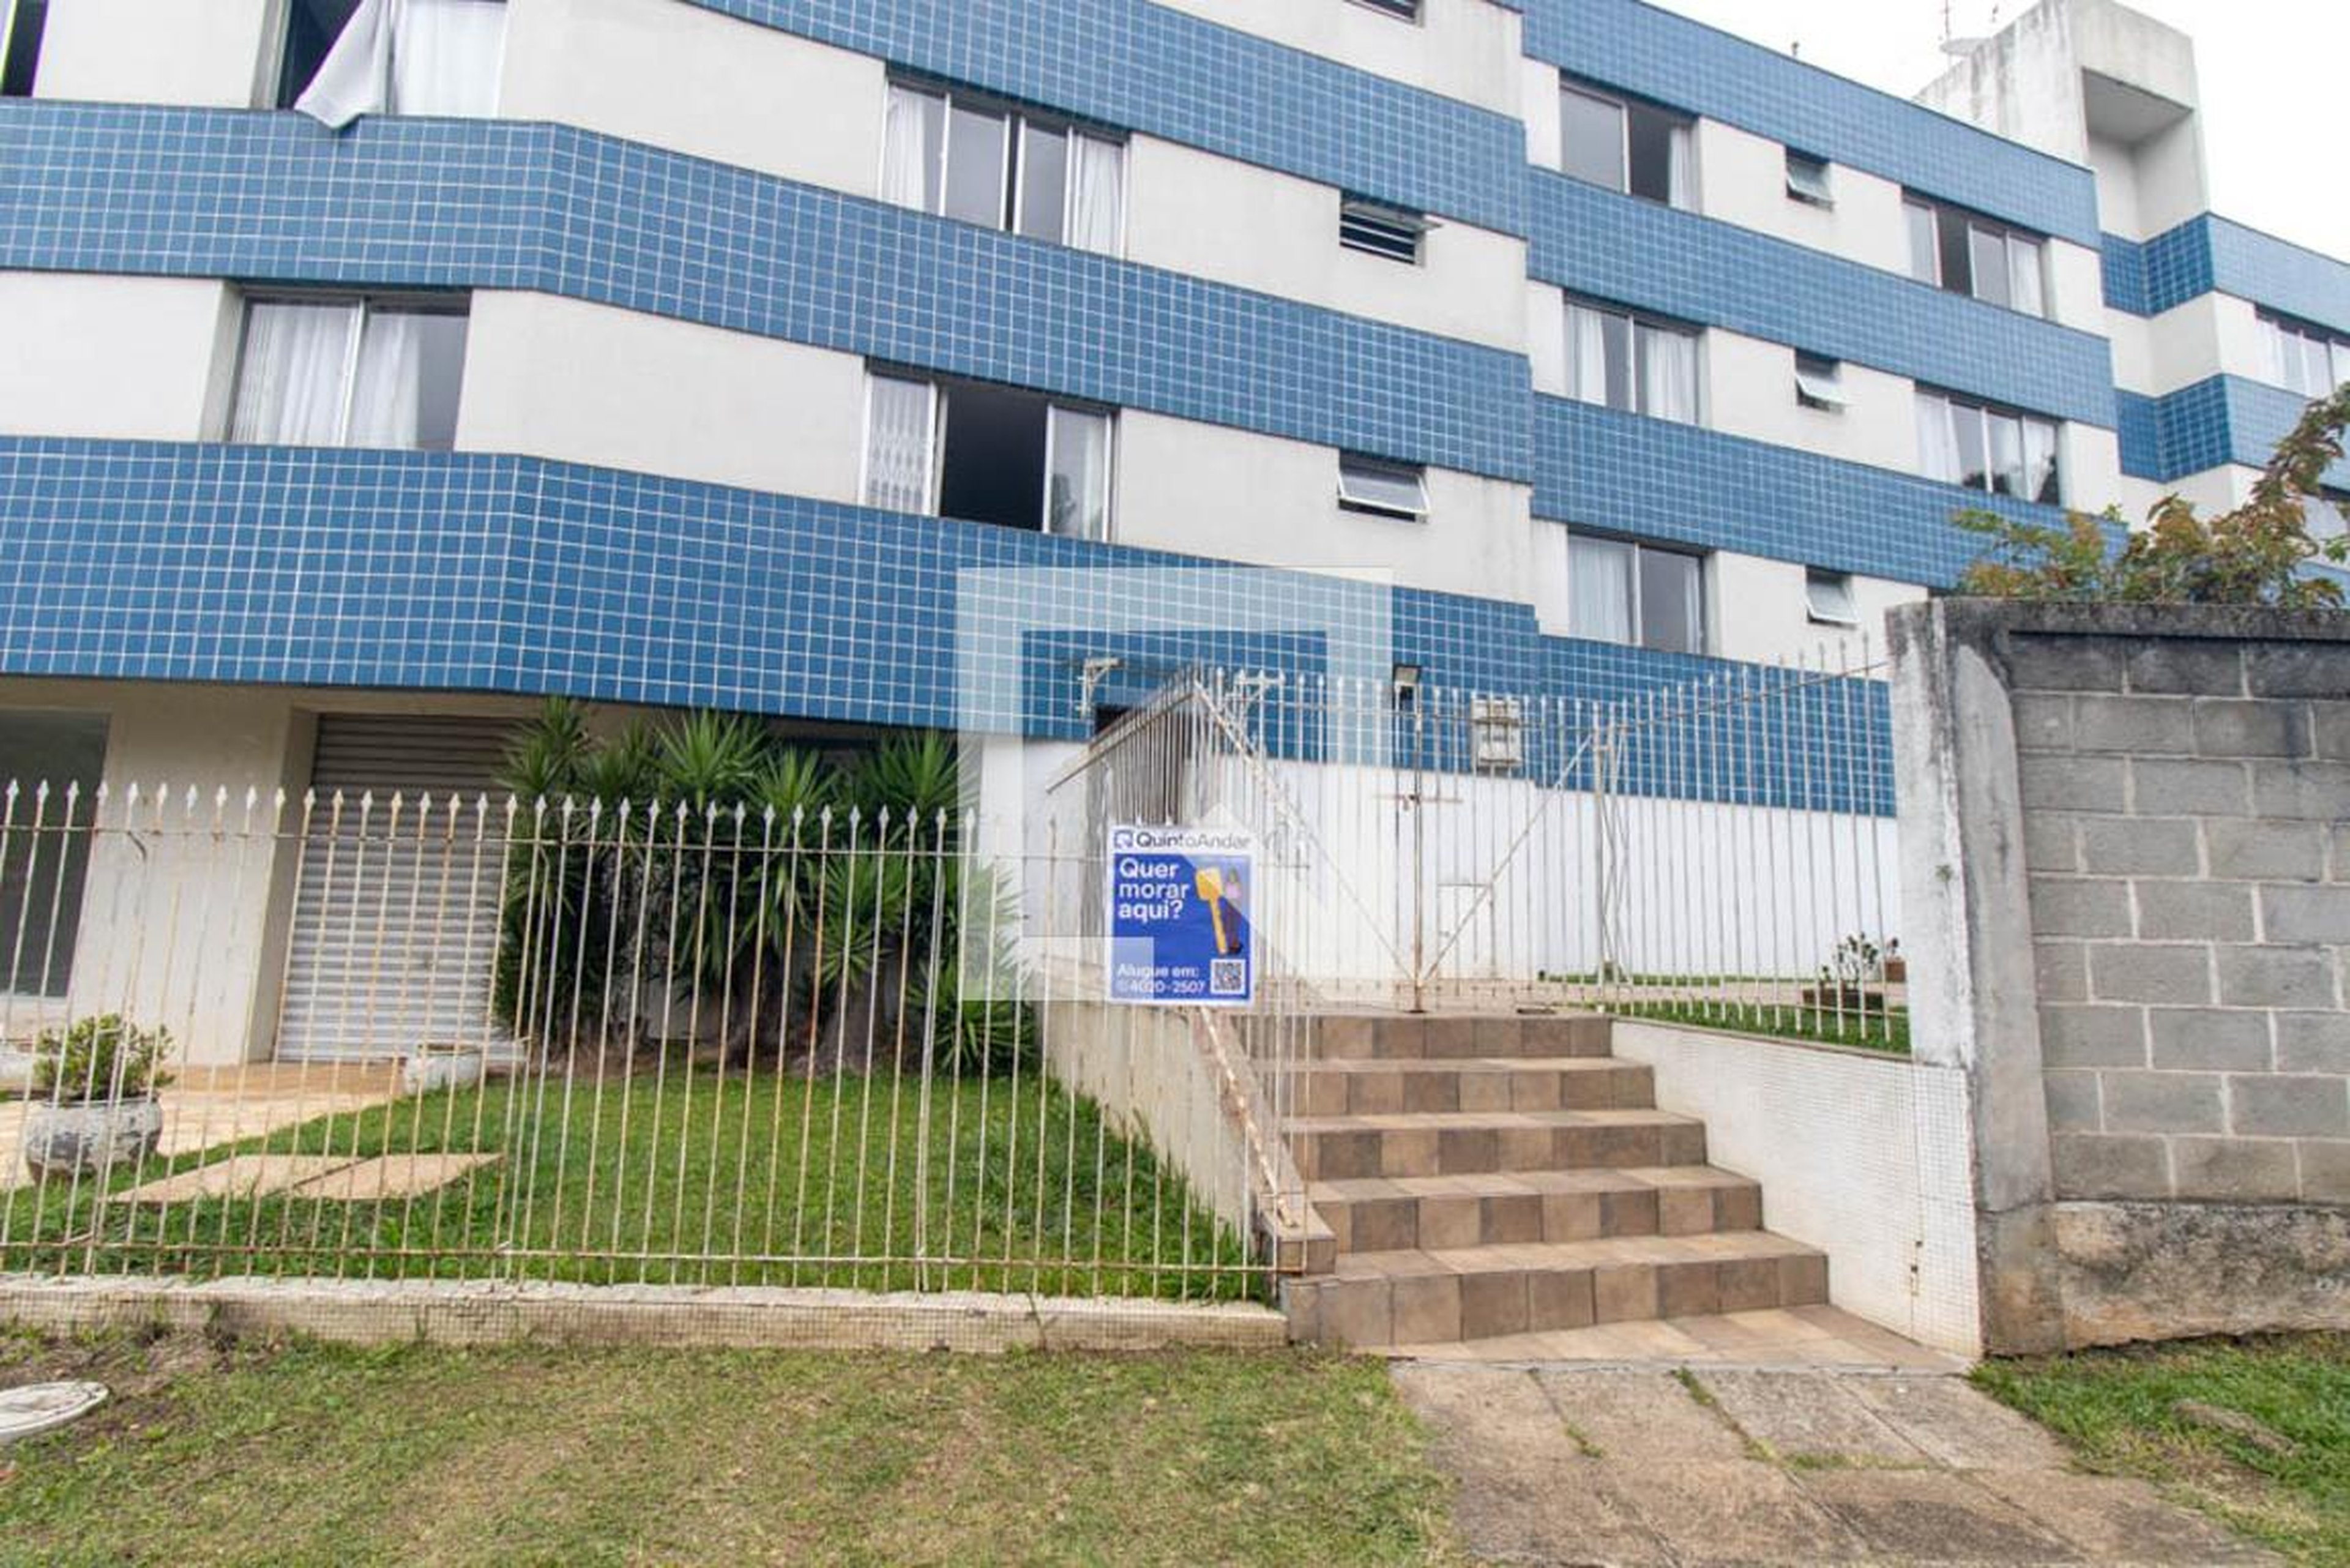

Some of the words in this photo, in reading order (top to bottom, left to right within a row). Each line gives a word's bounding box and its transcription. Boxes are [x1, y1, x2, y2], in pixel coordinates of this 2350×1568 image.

[1136, 832, 1250, 848] QuintoAndar
[1119, 857, 1179, 878] Quer
[1119, 883, 1189, 899] morar
[1117, 900, 1184, 923] aqui?
[1117, 963, 1169, 980] Alugue
[1171, 966, 1199, 977] em:
